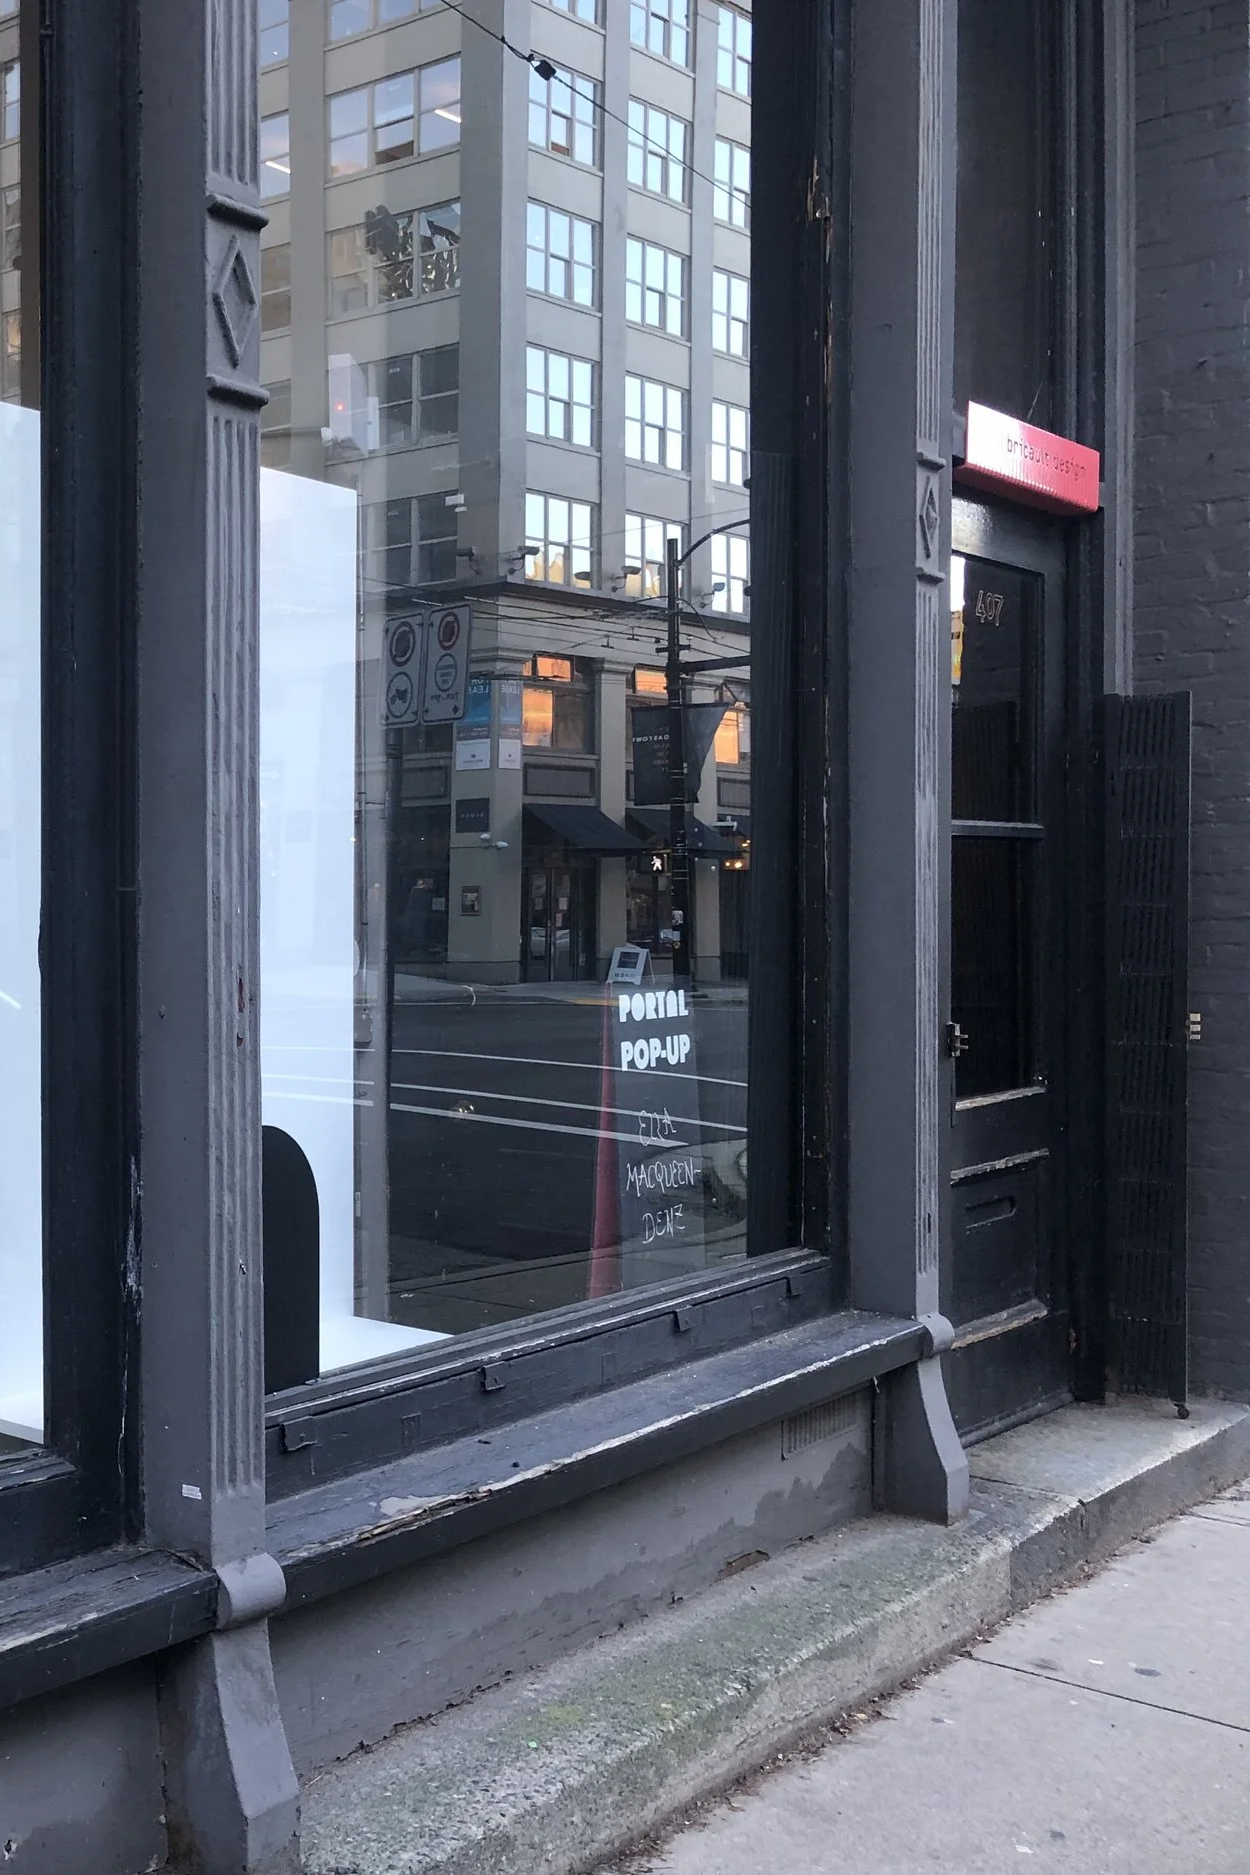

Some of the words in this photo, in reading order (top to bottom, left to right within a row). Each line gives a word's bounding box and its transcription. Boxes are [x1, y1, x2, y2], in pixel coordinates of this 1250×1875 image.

[1006, 435, 1050, 467] bricault
[1053, 450, 1087, 481] design
[975, 589, 1005, 627] 407
[618, 989, 689, 1022] PORTAL
[620, 1033, 691, 1072] POP-UP
[641, 1203, 686, 1244] DENZ
